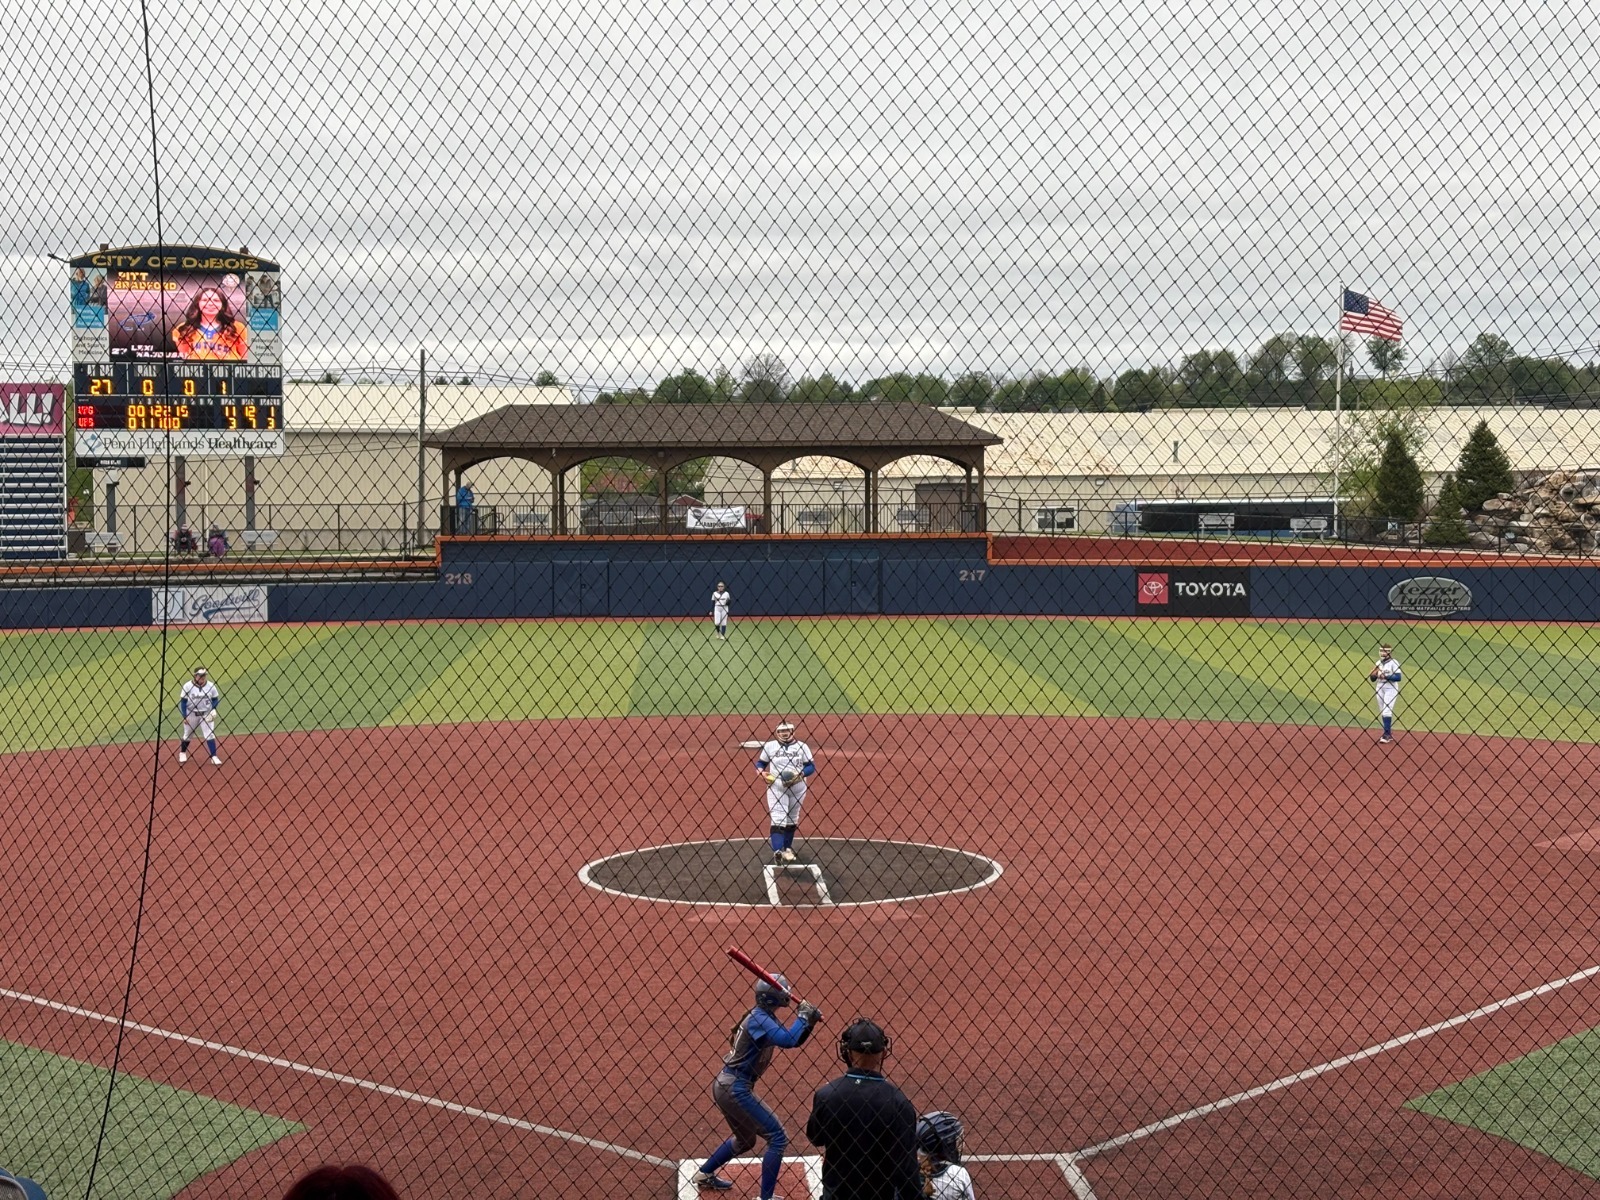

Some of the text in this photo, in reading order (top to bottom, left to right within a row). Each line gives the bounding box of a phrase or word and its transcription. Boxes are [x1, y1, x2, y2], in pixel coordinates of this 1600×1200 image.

[92, 255, 143, 267] CITY
[147, 256, 177, 268] OF
[118, 271, 149, 281] PITT
[114, 281, 177, 290] BRADFORD
[91, 379, 112, 395] 27
[142, 379, 154, 395] 0
[184, 379, 195, 395] 0
[103, 437, 277, 452] Penn Highlands Healthcare
[444, 572, 472, 585] 218
[959, 569, 986, 581] 217
[1174, 582, 1247, 596] TOYOTA
[1398, 583, 1461, 595] Lezzer
[1400, 594, 1459, 606] Lumber
